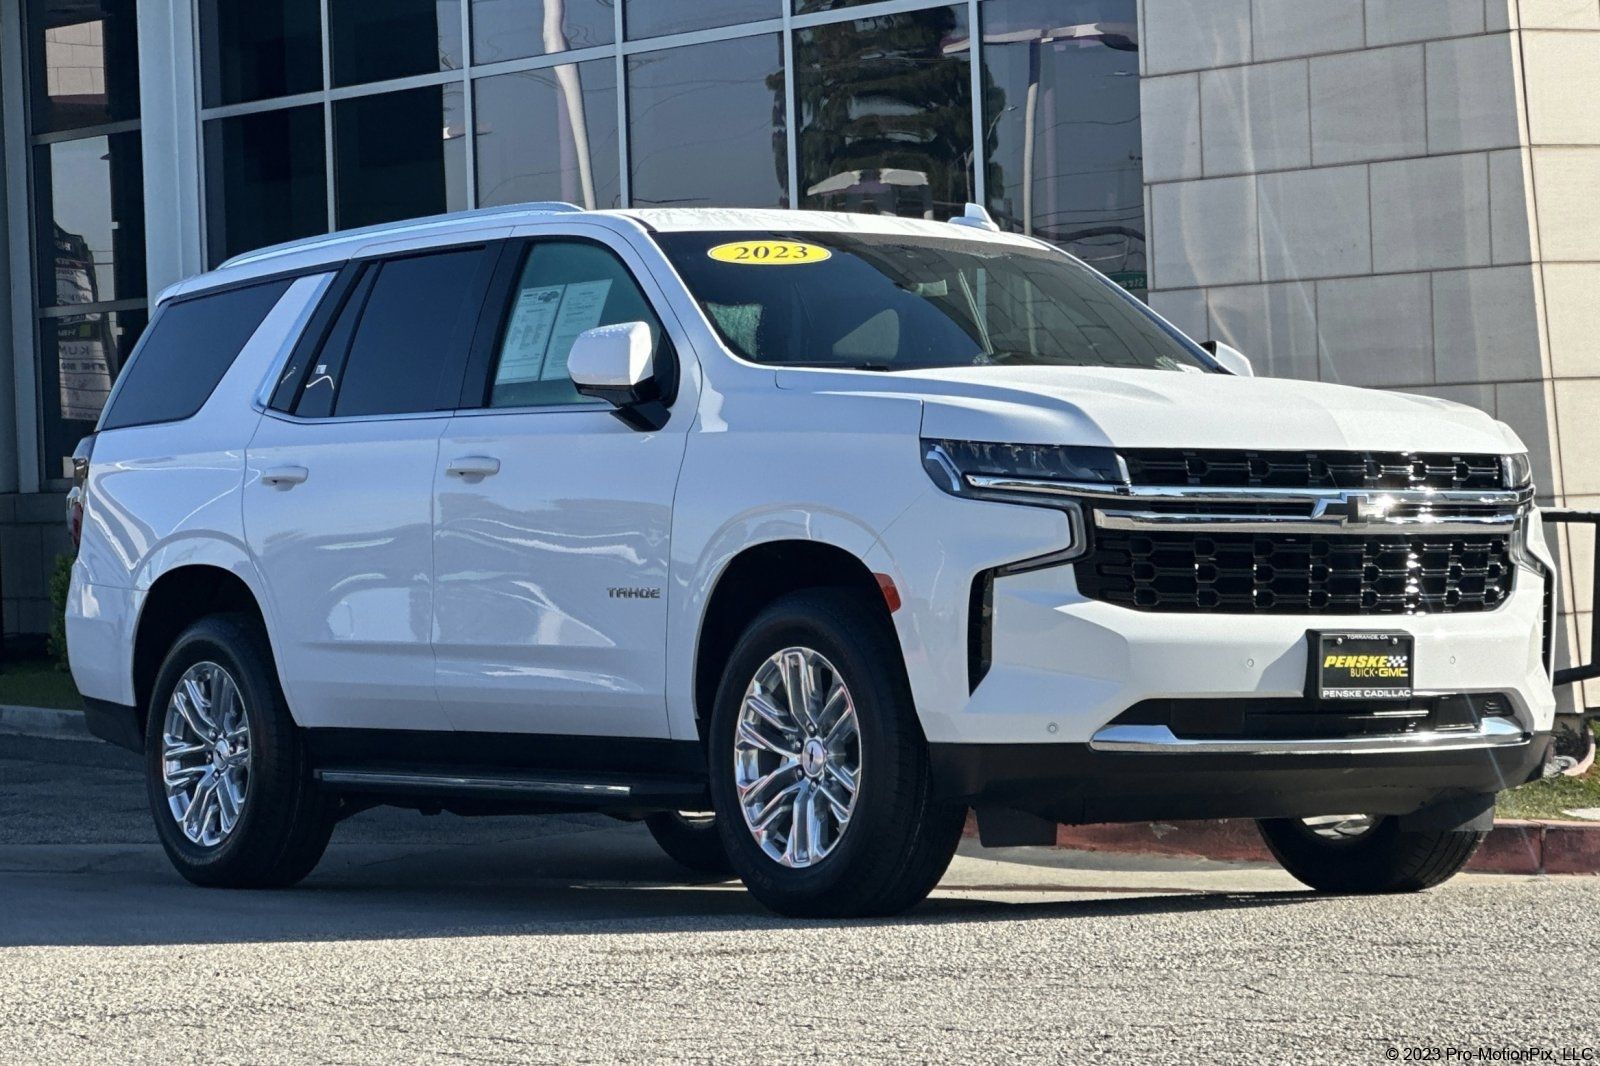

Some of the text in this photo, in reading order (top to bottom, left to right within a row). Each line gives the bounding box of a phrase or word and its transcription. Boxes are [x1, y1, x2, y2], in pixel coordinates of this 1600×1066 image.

[734, 246, 808, 260] 2023
[607, 587, 661, 599] TAHOE
[1324, 655, 1388, 668] PENSKE
[1322, 690, 1361, 698] PENSKE
